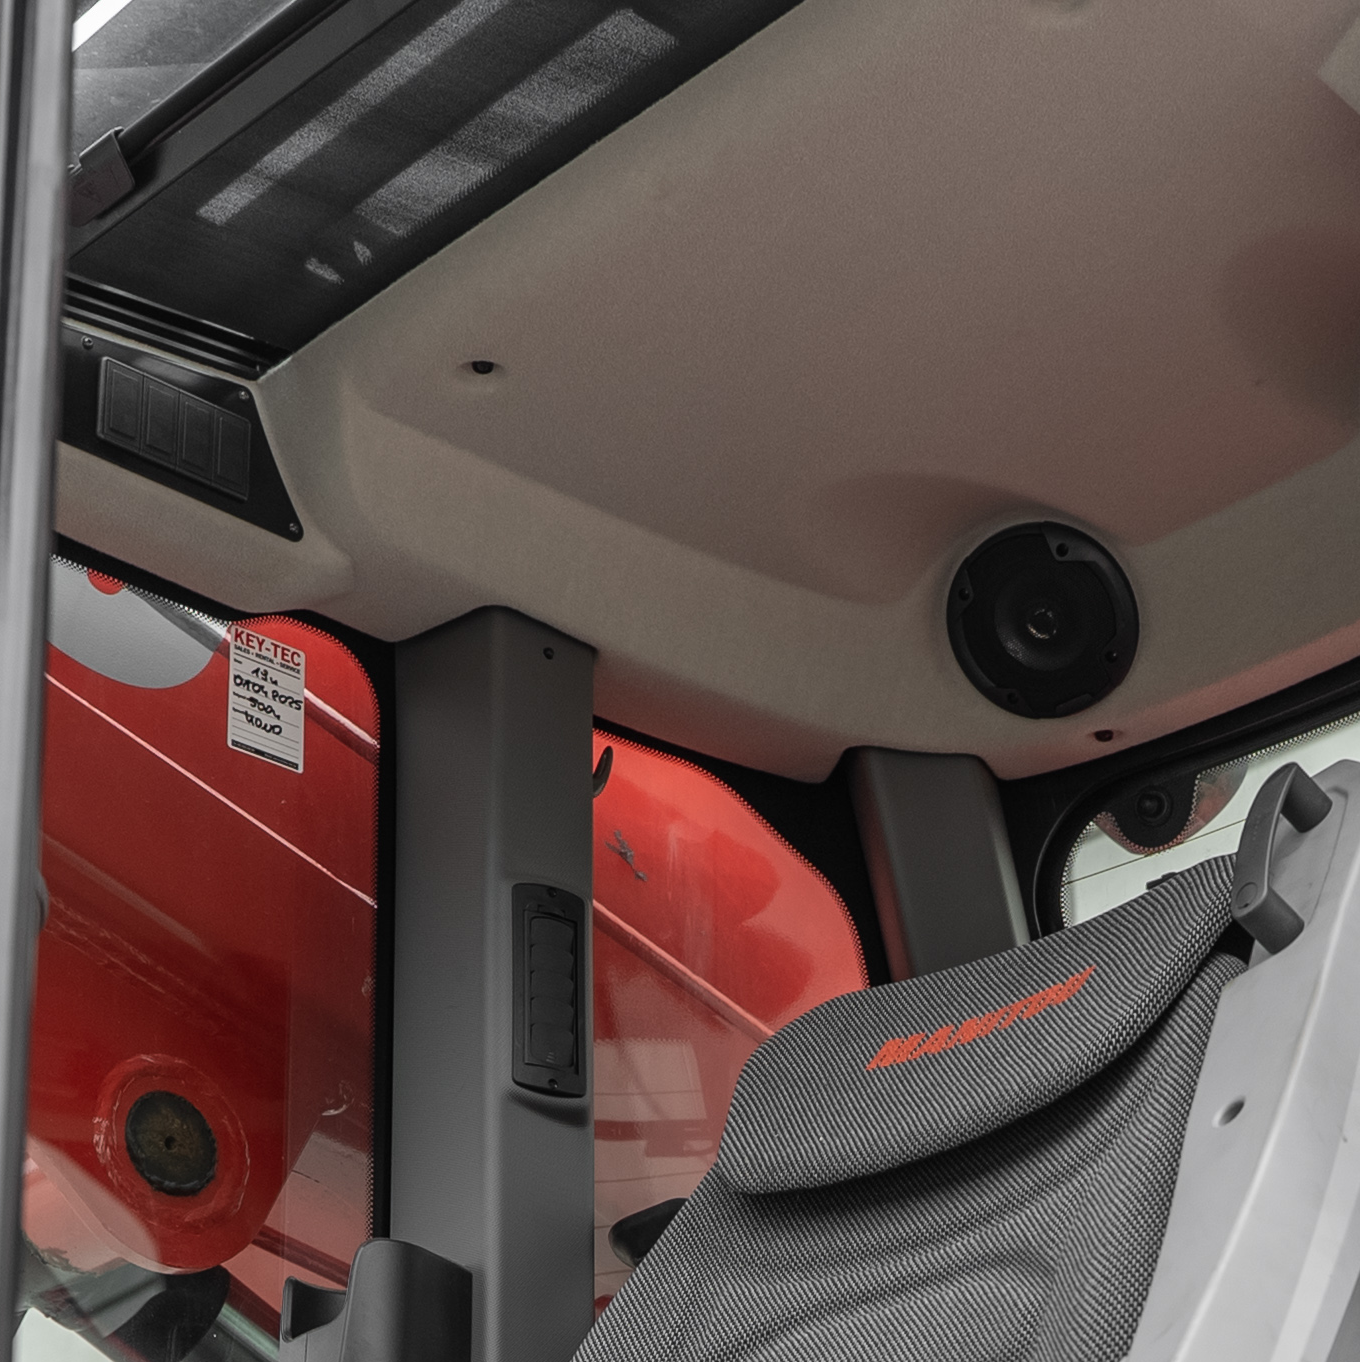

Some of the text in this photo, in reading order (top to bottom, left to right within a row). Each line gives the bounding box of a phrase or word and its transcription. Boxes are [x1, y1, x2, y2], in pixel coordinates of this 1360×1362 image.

[233, 644, 250, 656] SALES
[234, 628, 301, 667] KEY-TEC
[865, 965, 1097, 1071] MANITOU
